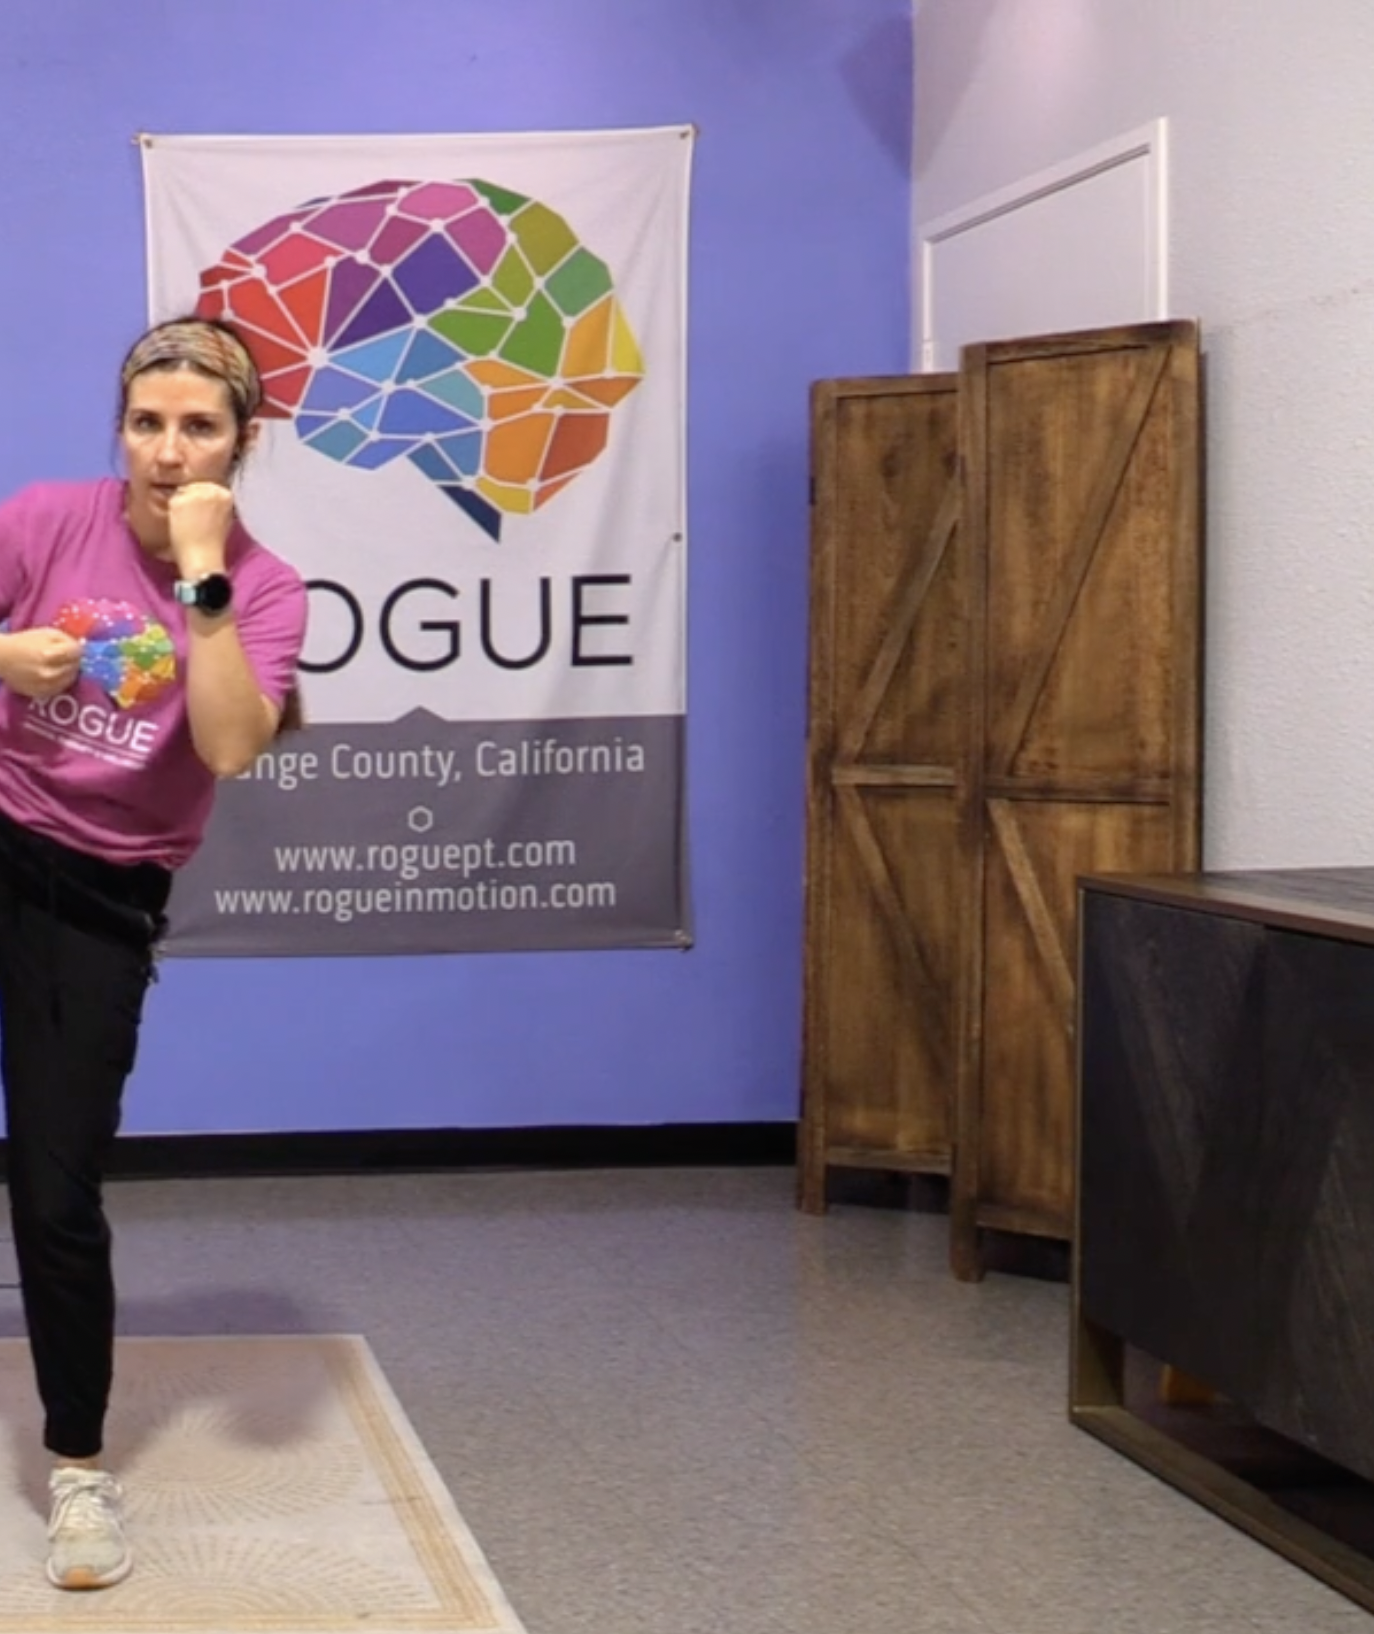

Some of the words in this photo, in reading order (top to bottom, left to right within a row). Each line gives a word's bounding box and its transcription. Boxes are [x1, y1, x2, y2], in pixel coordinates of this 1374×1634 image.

[297, 574, 633, 673] OGUE
[236, 752, 319, 791] nge
[331, 742, 462, 783] County,
[475, 737, 646, 779] California
[274, 836, 577, 879] www.roguept.com
[214, 880, 617, 922] www.rogueinmotion.com
